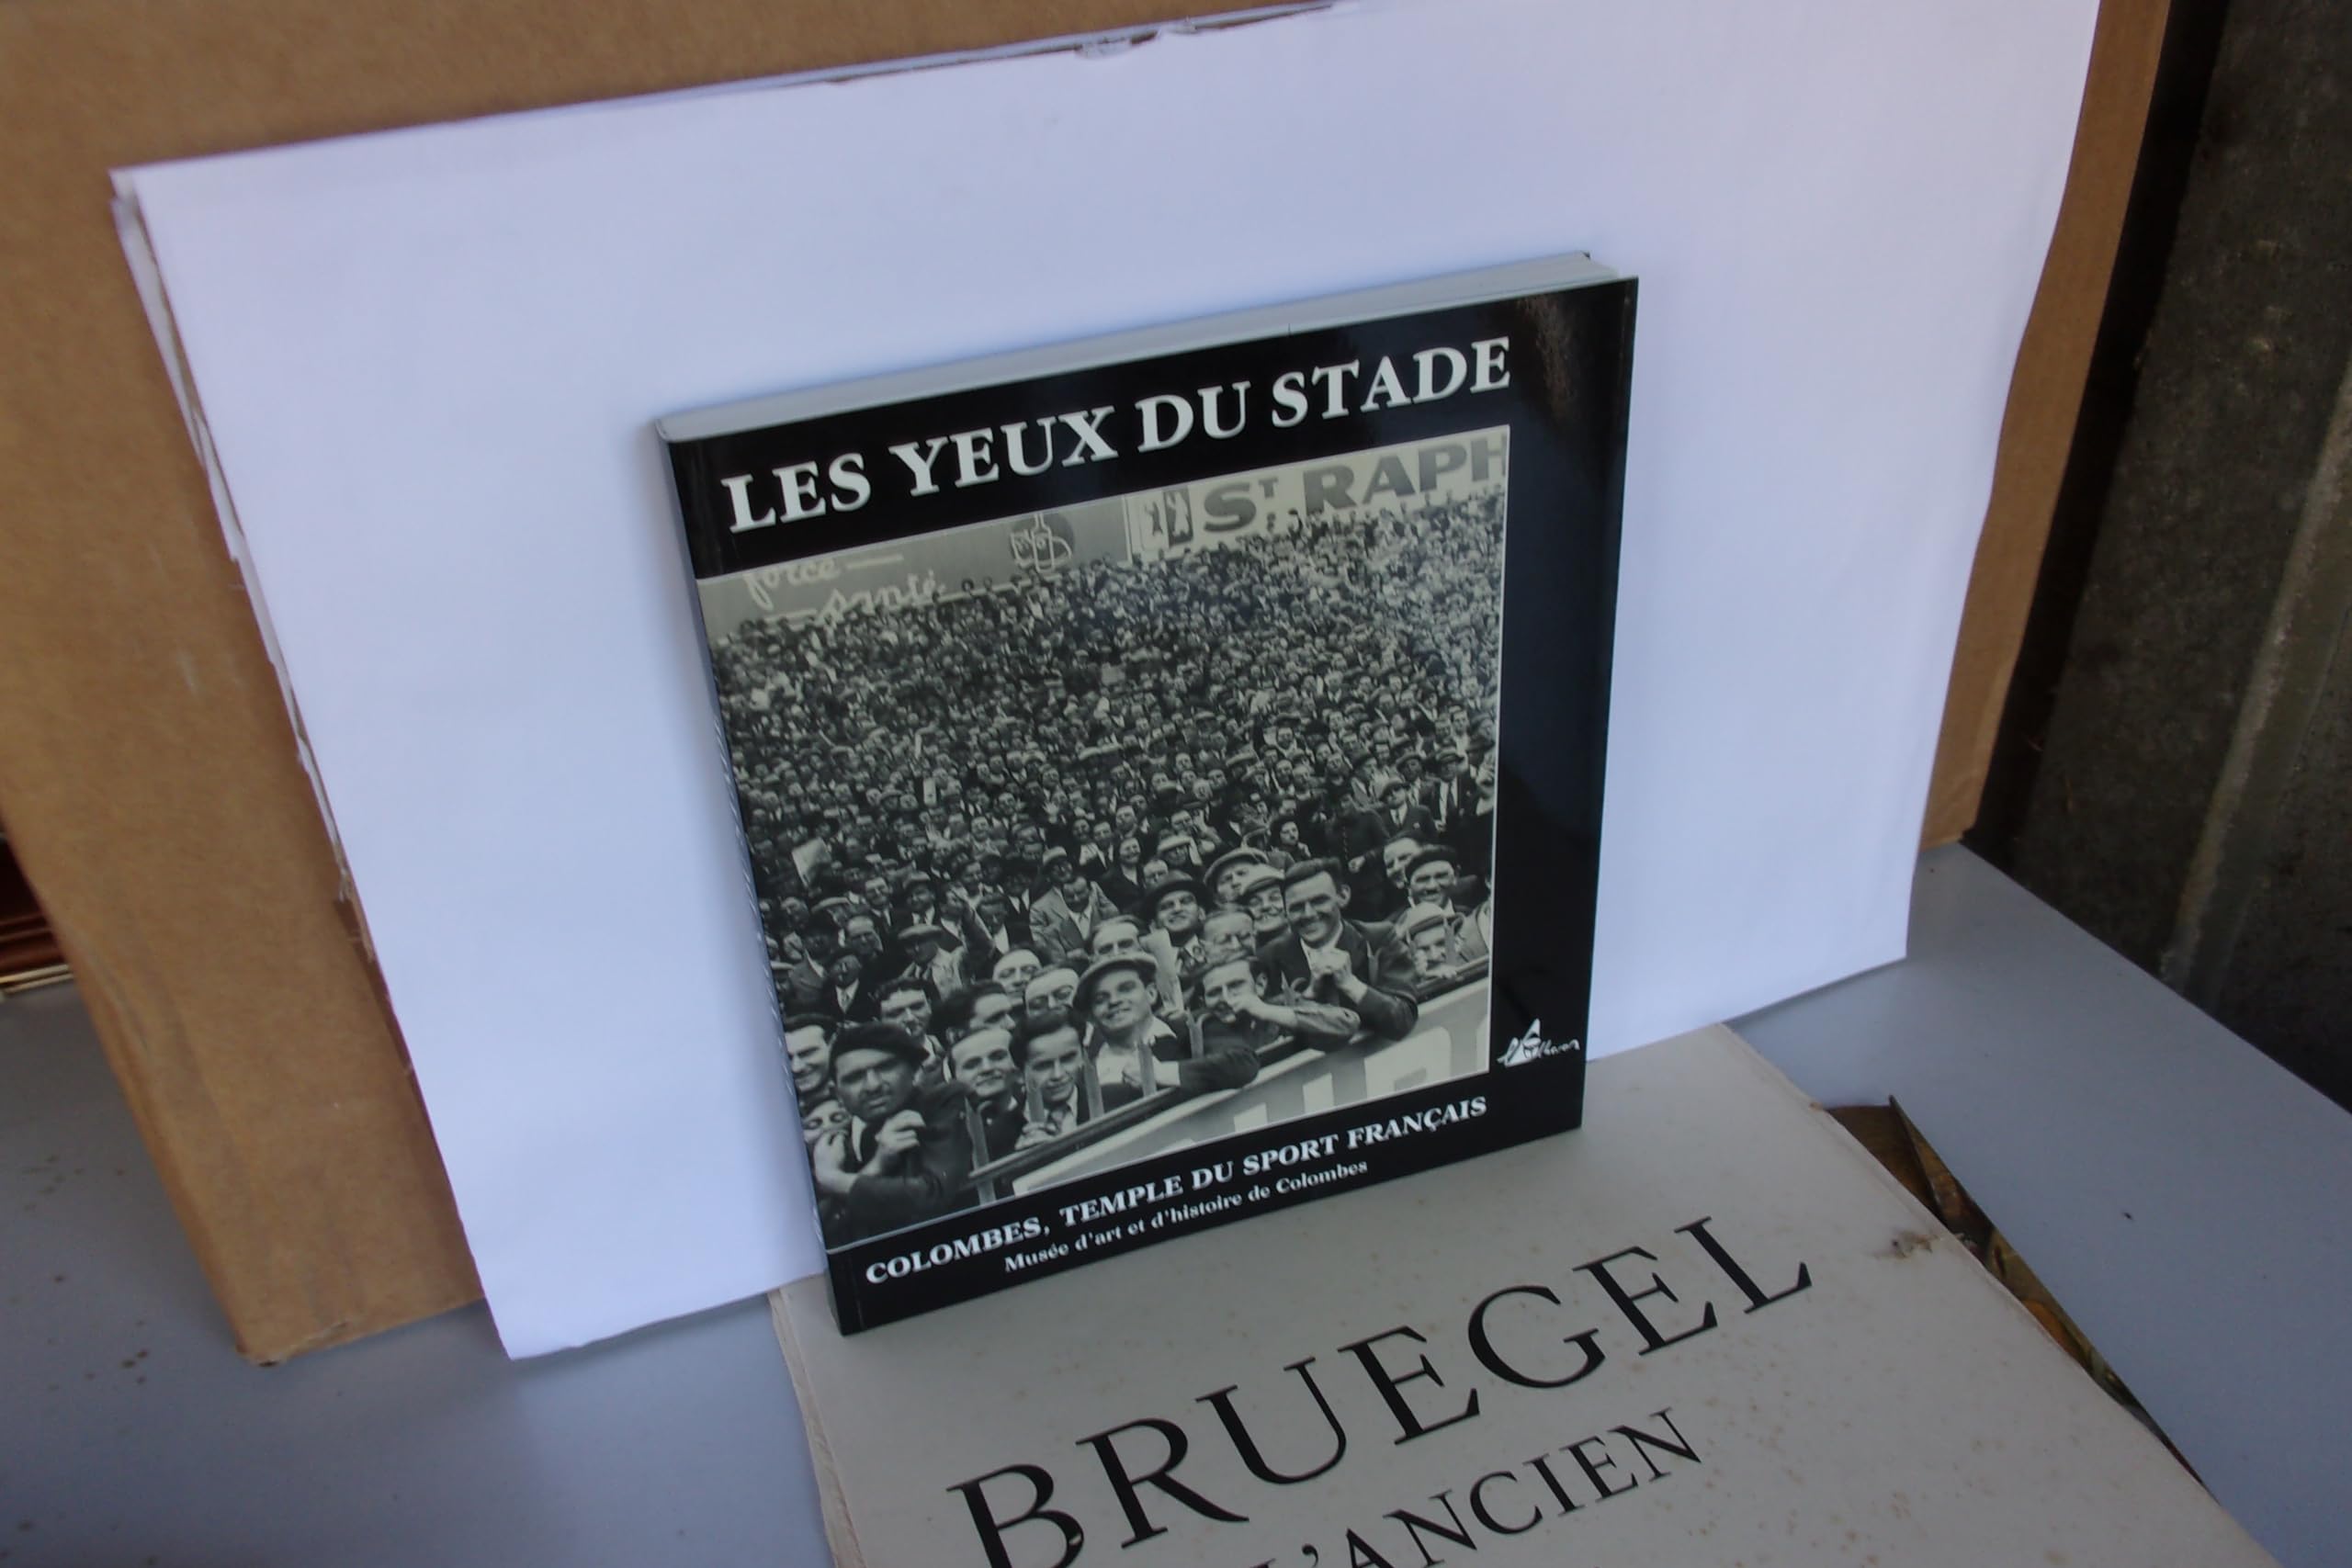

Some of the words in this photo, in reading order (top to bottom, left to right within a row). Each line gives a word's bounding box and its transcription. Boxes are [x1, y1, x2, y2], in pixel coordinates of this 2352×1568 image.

[721, 453, 871, 533] LES
[888, 405, 1118, 497] YEUX
[1135, 381, 1251, 454] DU
[1271, 336, 1510, 428] STADE
[1302, 432, 1507, 514] RAPH
[865, 1216, 1051, 1284] COLOMBES,
[1058, 1175, 1183, 1227] TEMPLE
[1191, 1160, 1234, 1190] DU
[1242, 1133, 1339, 1177] SPORT
[1347, 1095, 1487, 1150] FRANÇAIS
[1004, 1244, 1069, 1273] Musée
[1074, 1226, 1123, 1252] d'art
[1126, 1219, 1147, 1236] et
[1150, 1190, 1243, 1230] d'histoire
[1247, 1184, 1271, 1202] de
[1275, 1160, 1369, 1194] Colombes
[947, 1215, 1813, 1568] BRUEGEL
[1248, 1407, 1702, 1568] 'ANCIEN
